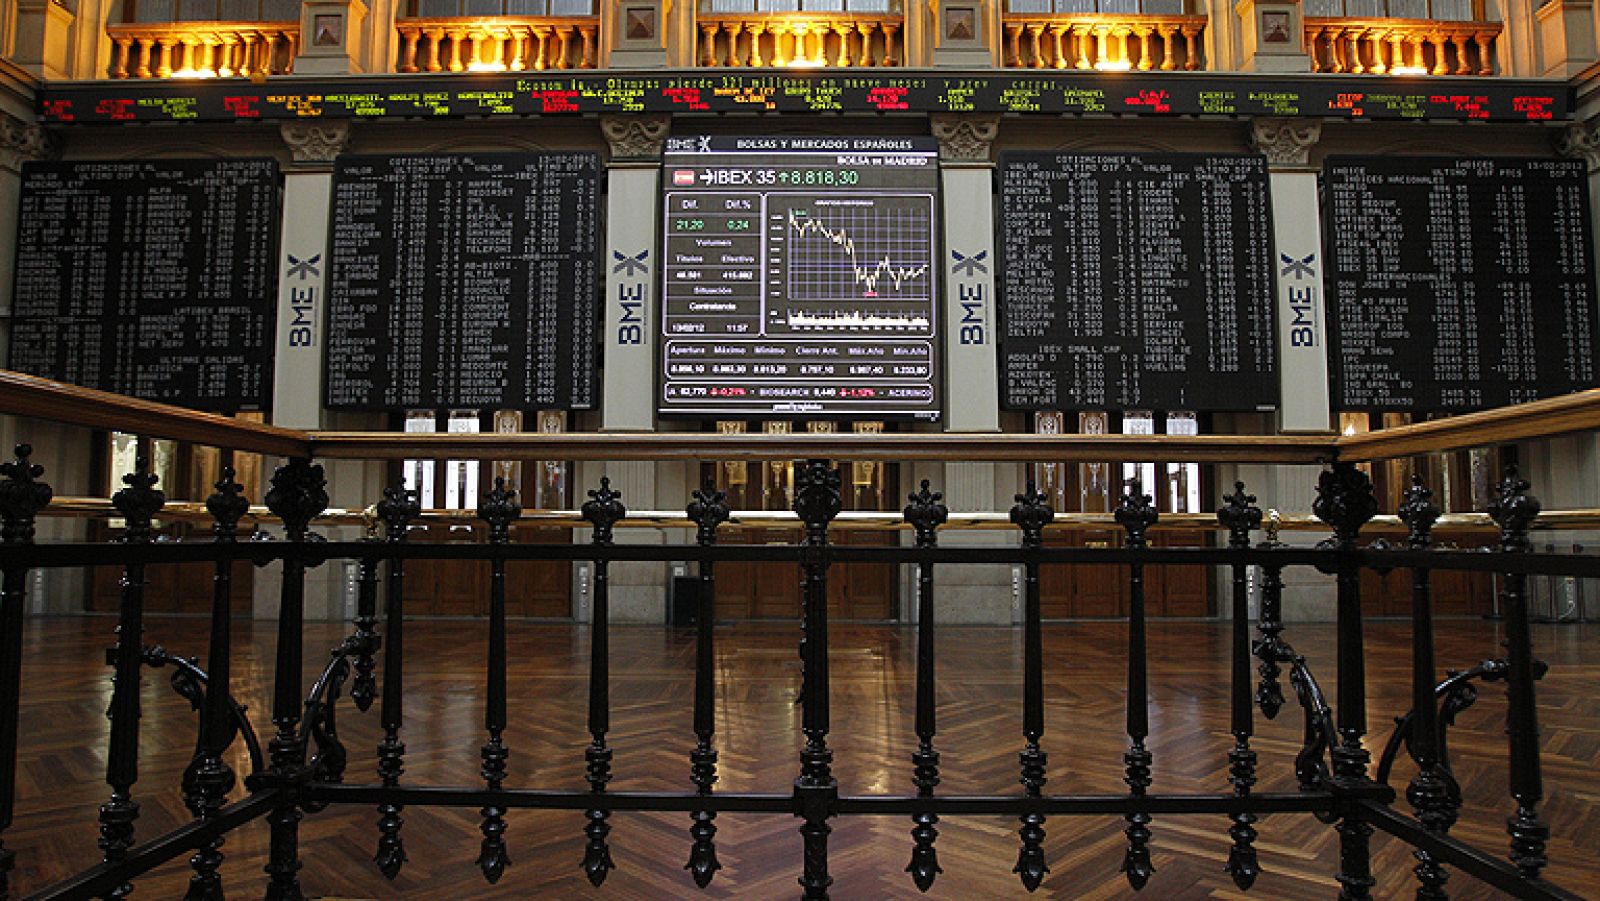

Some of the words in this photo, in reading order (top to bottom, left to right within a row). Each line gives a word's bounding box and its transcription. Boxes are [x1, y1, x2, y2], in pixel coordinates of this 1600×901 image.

[737, 140, 777, 152] BOLSAS
[782, 140, 790, 151] Y
[792, 140, 850, 152] MERCADOS
[854, 138, 913, 152] ESPAÑOLES
[837, 156, 870, 166] BOLSA
[885, 156, 929, 167] MADRID
[714, 171, 753, 184] IBEX
[756, 171, 776, 184] 35
[289, 287, 313, 347] BME
[619, 283, 642, 345] BME
[959, 283, 984, 345] BME
[1289, 286, 1313, 347] BME
